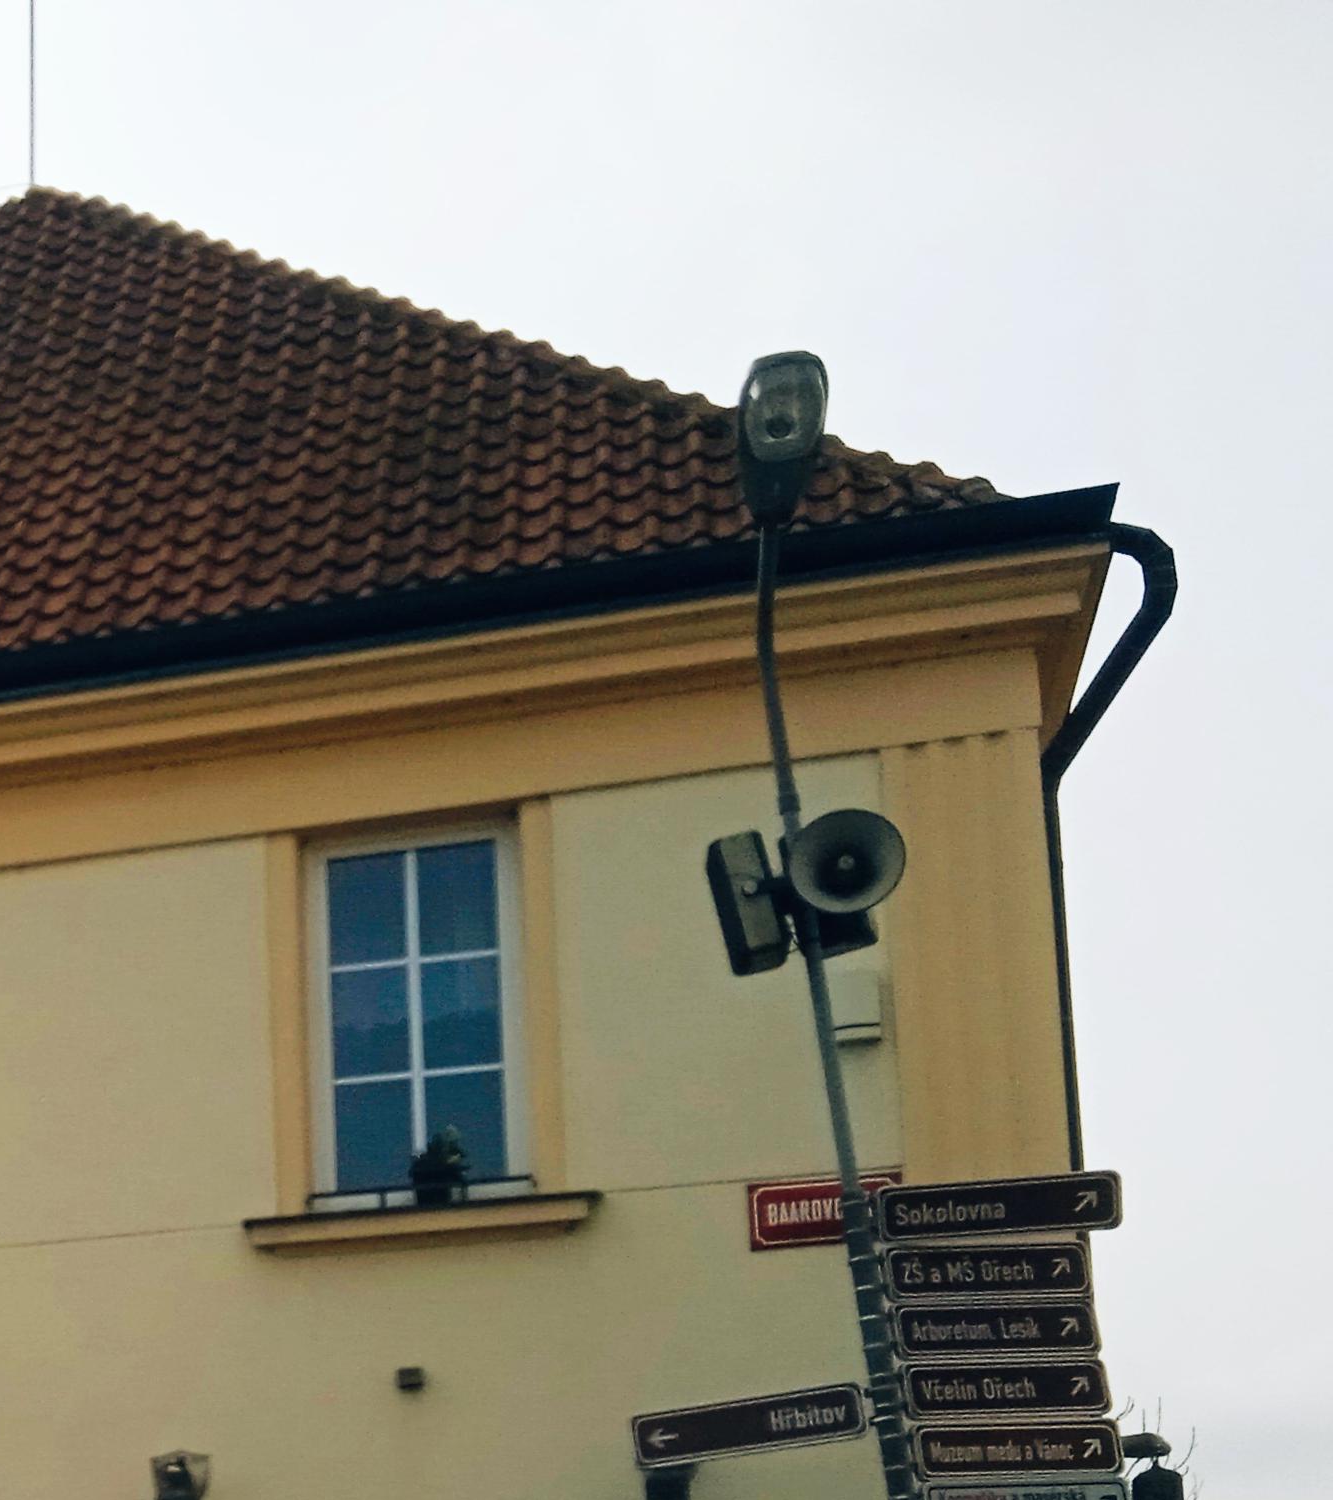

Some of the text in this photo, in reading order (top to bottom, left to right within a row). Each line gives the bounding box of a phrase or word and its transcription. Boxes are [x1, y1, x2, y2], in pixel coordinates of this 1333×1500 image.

[896, 1201, 1006, 1226] Sokolovna
[902, 1256, 1035, 1284] ZŠ a MŠ Ořech
[983, 1376, 1037, 1399] Ořech
[770, 1404, 846, 1432] Hřbitov
[1025, 1444, 1033, 1461] a
